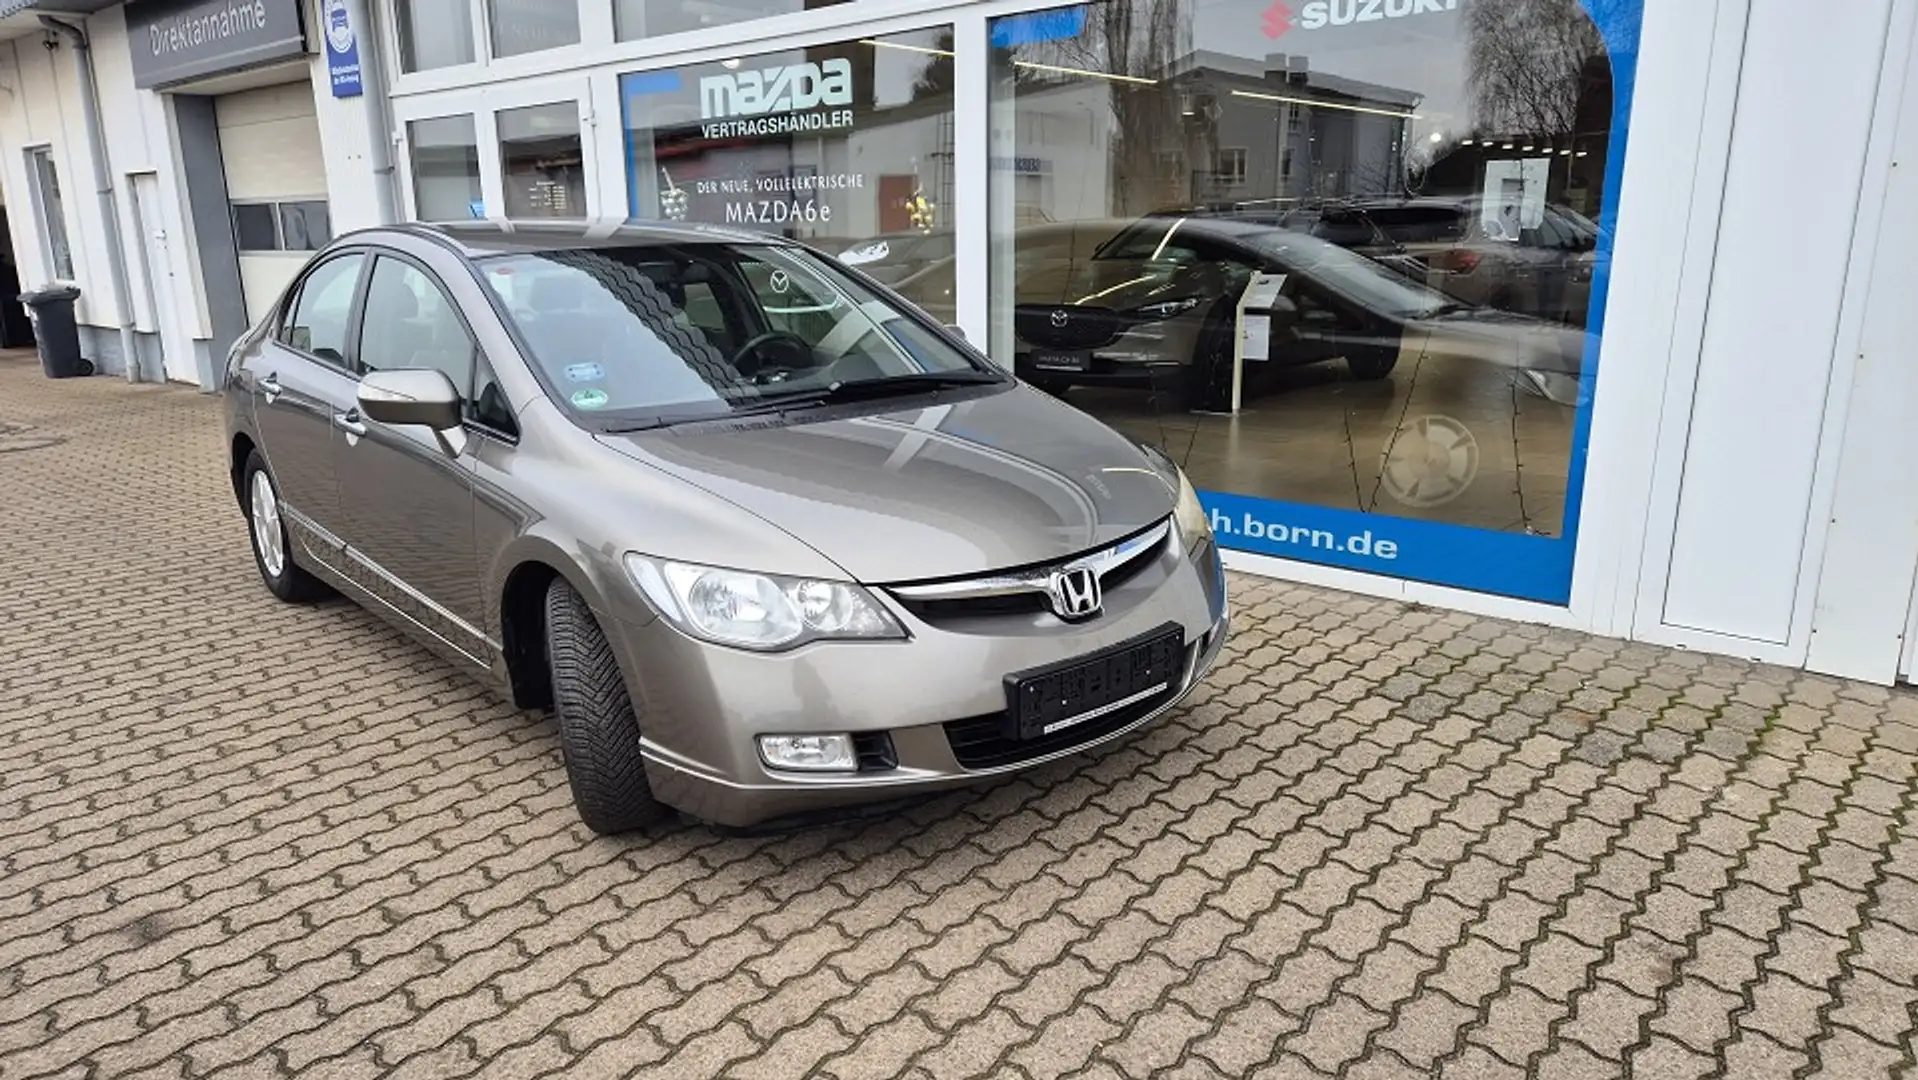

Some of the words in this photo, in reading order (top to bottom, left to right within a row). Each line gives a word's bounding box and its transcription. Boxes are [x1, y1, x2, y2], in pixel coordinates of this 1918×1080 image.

[149, 0, 266, 56] Direktannahme
[702, 110, 854, 139] VERTRAGSHÄNDLER
[697, 181, 718, 194] DER
[720, 179, 753, 193] NEUE,
[755, 173, 864, 192] VOLLELEKTRISCHE
[725, 198, 831, 224] MAZDA6e
